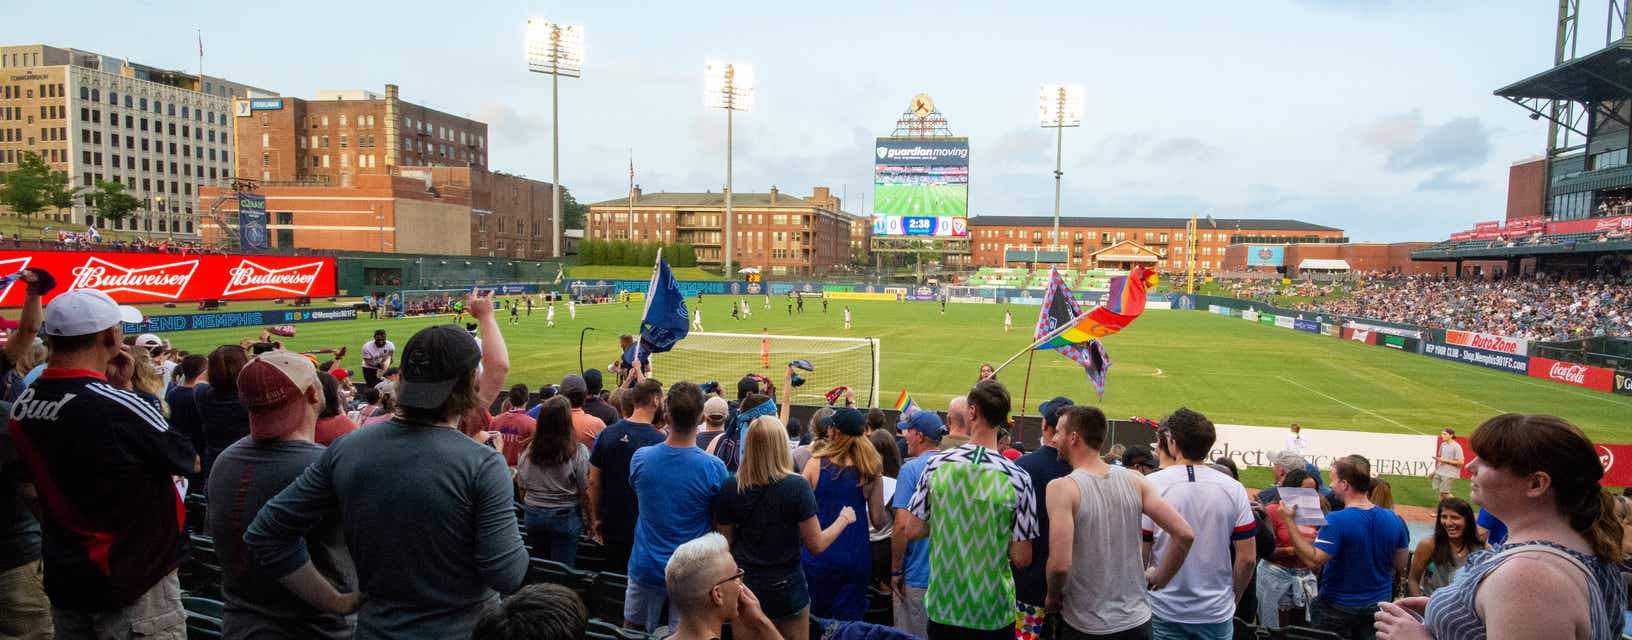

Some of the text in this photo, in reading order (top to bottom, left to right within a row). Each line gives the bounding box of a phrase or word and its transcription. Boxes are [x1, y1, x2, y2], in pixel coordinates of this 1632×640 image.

[888, 146, 968, 158] guardian moving
[909, 218, 930, 228] 2:38
[72, 266, 192, 288] Budweiser
[229, 268, 315, 285] Budweiser
[124, 312, 264, 333] EFEND MEMPHIS
[1426, 344, 1434, 352] REP
[1447, 348, 1459, 358] CLUB
[1472, 334, 1517, 352] AutoZone
[10, 388, 77, 421] Bud
[1209, 442, 1264, 466] elect
[1370, 457, 1432, 476] HERAPY
